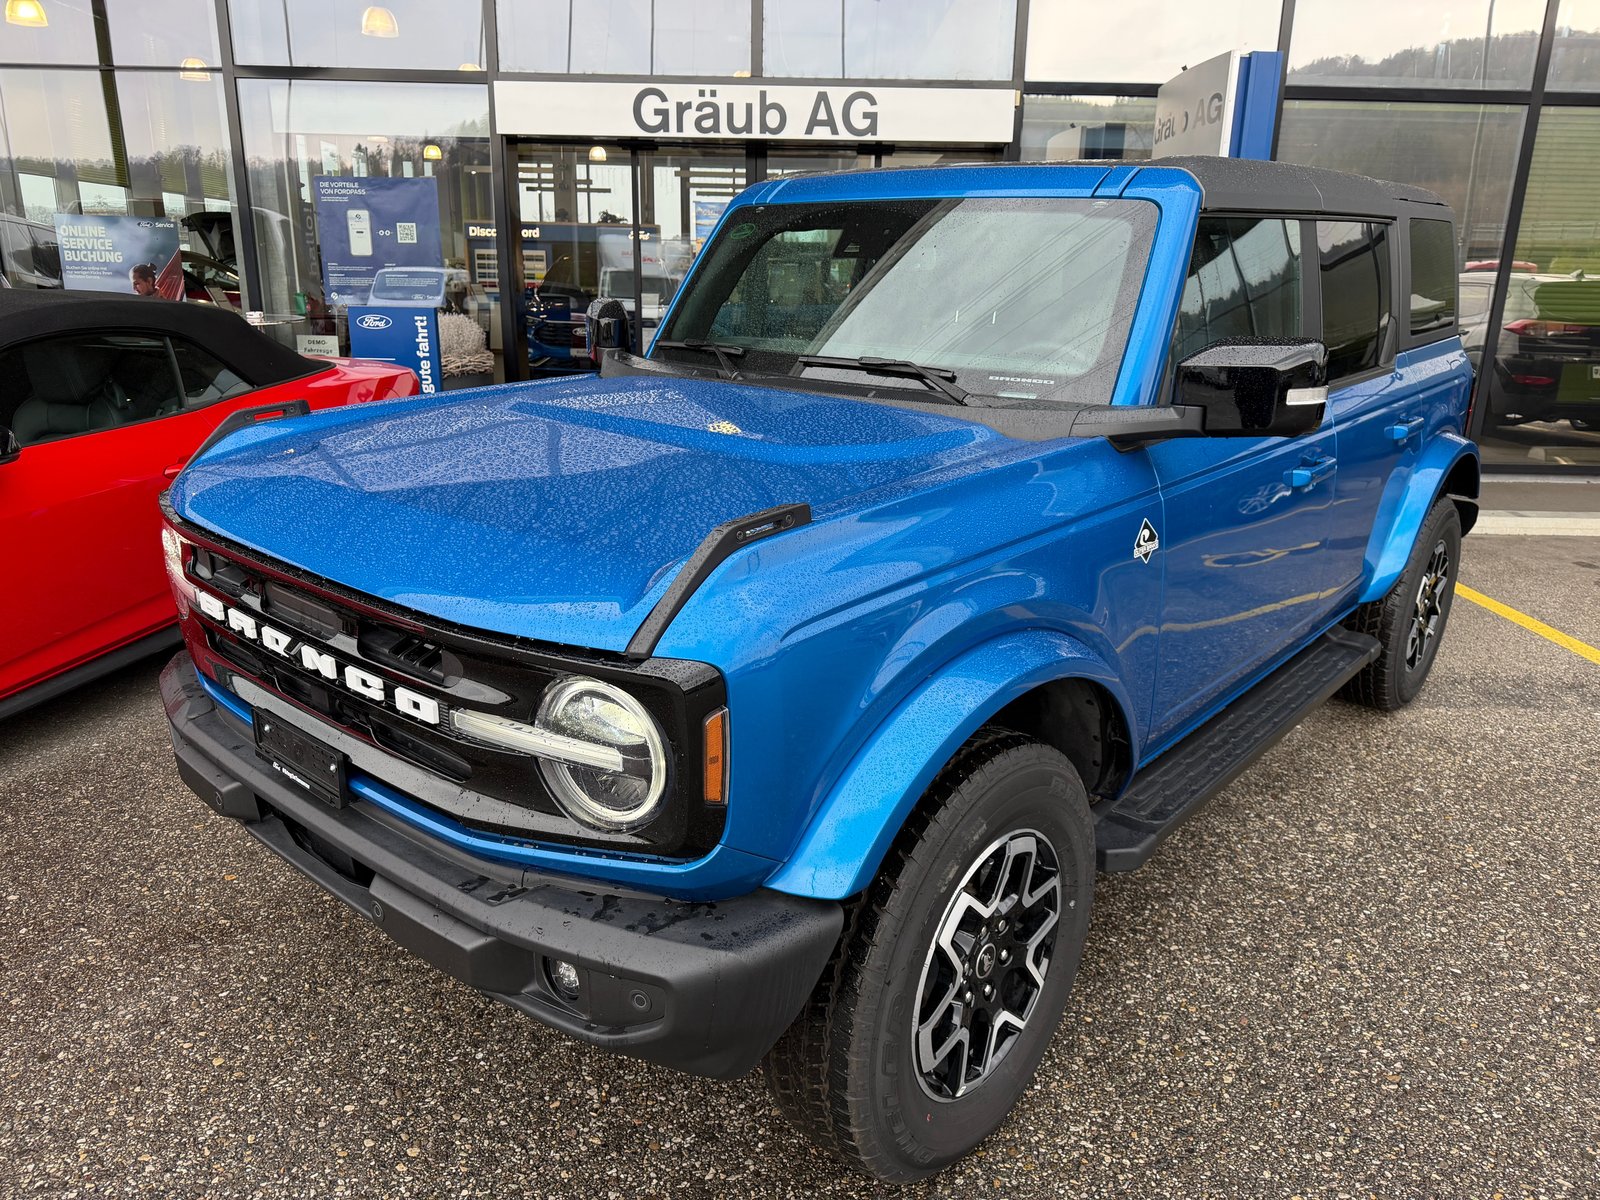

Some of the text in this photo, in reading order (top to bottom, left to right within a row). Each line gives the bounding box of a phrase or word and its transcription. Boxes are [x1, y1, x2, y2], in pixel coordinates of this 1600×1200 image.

[632, 87, 878, 137] Gräub AG
[1192, 92, 1223, 130] AG
[60, 225, 106, 238] ONLINE
[61, 238, 113, 250] SERVICE
[63, 250, 123, 263] BUCHUNG
[414, 315, 430, 359] fahrt!
[988, 375, 1055, 385] BRONCO
[198, 590, 440, 725] BRONCO
